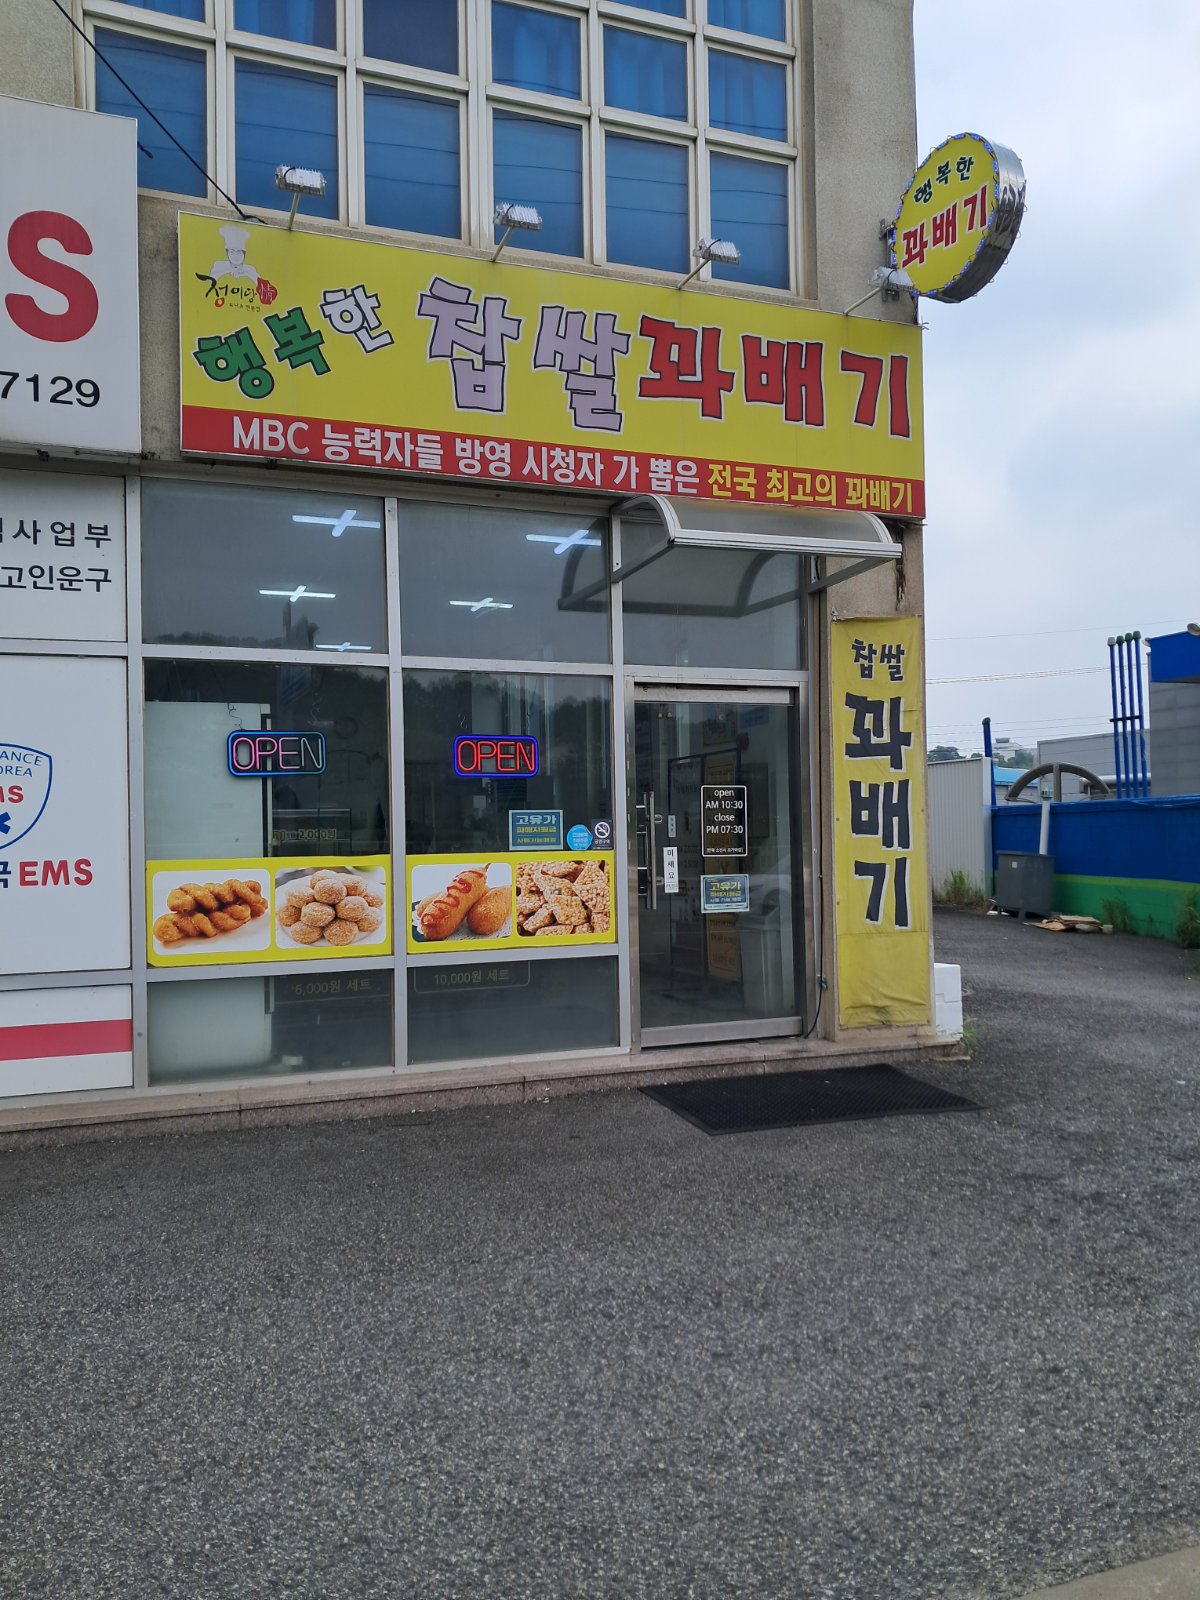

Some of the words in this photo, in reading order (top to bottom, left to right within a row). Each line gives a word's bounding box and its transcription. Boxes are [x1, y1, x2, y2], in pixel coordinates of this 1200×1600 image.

[914, 157, 974, 203] 행복한
[902, 185, 987, 268] 꽈배기
[193, 284, 395, 399] 행복한
[417, 276, 632, 433] 찹쌀
[638, 314, 911, 438] 꽈배기
[0, 371, 100, 407] 7129
[233, 416, 309, 455] MBC
[321, 424, 443, 470] 능력자들
[455, 438, 511, 477] 방영
[522, 446, 604, 486] 시청자
[613, 455, 639, 489] 가
[649, 457, 700, 494] 뽑은
[708, 463, 757, 499] 전국
[766, 469, 836, 506] 최고의
[845, 477, 912, 513] 꽈배기
[0, 517, 111, 548] 사업부
[851, 639, 904, 682] 찹쌀
[232, 737, 323, 770] OPEN
[457, 740, 535, 771] OPEN
[705, 800, 719, 809] AM
[721, 800, 743, 809] 10:30
[713, 789, 735, 799] open
[516, 815, 557, 825] 고유가
[714, 812, 735, 822] close
[845, 692, 912, 928] 꽈배기
[706, 825, 719, 834] PM
[720, 825, 744, 834] 07:30
[19, 858, 93, 886] EMS
[666, 849, 675, 879] 미세요
[709, 881, 742, 891] 고유가
